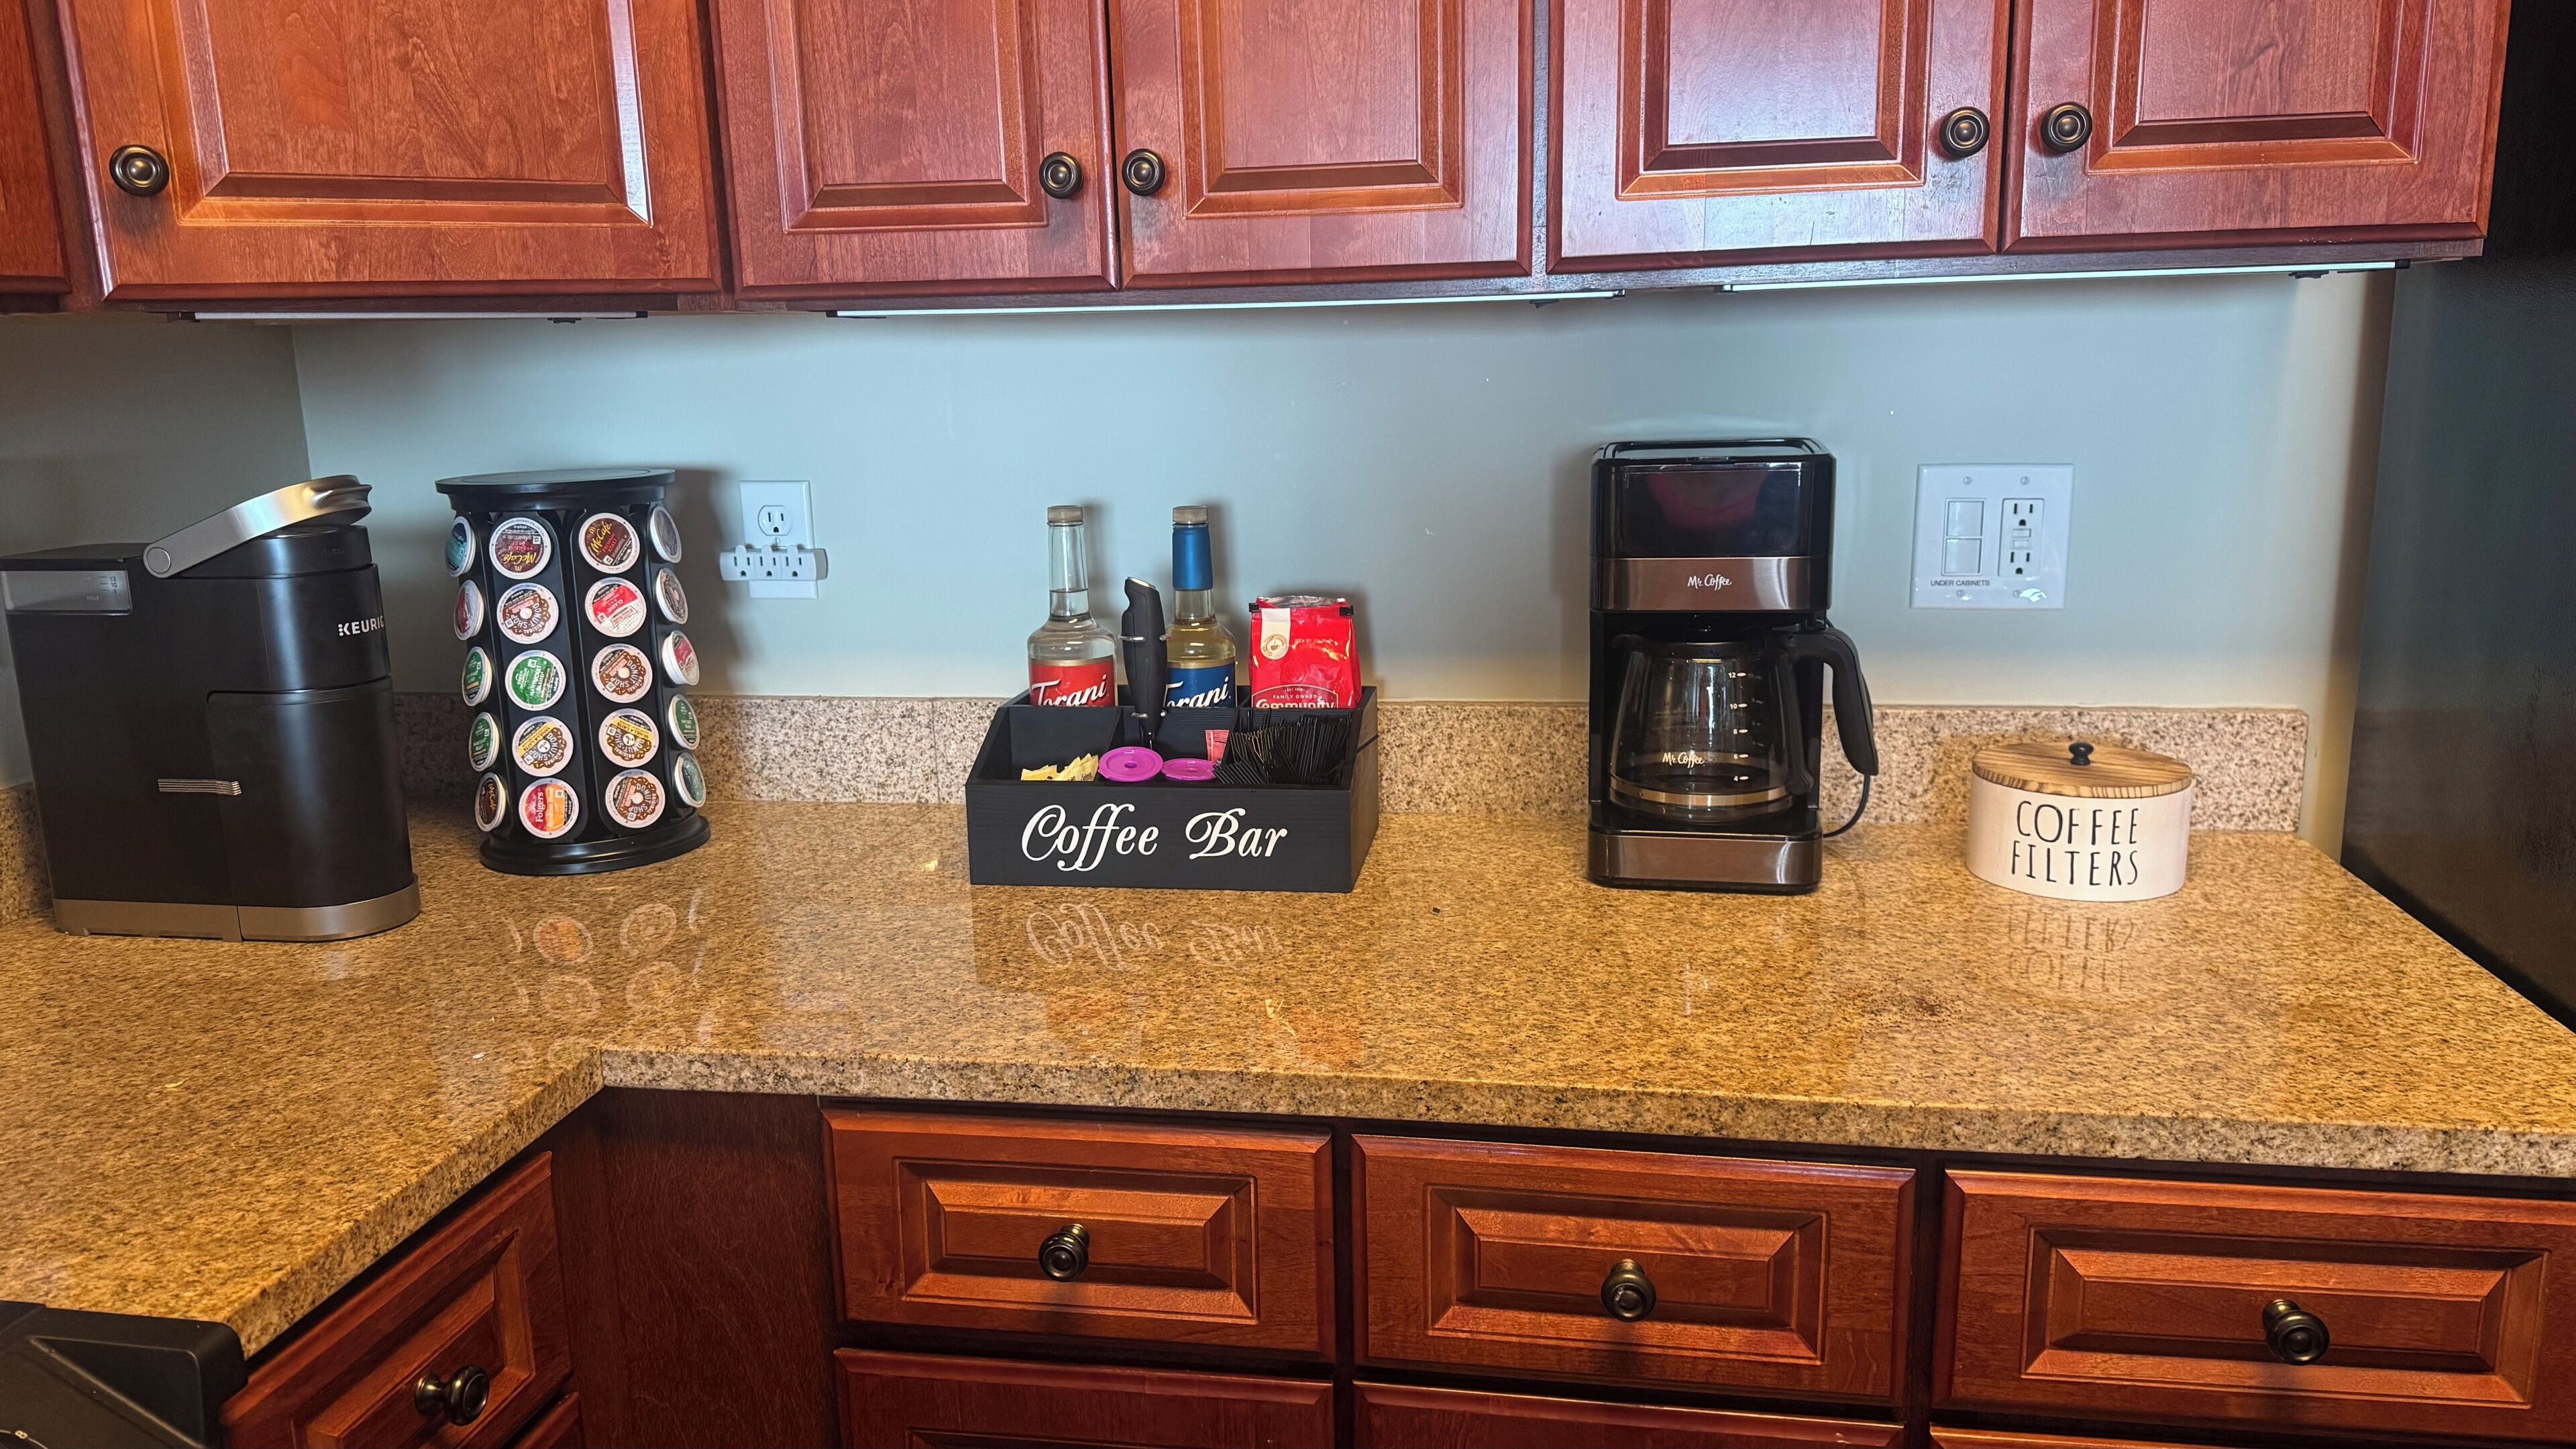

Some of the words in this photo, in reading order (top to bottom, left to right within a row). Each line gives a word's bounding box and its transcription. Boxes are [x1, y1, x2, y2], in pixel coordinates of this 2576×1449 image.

[1687, 576, 1703, 589] Mr.
[1704, 574, 1733, 590] Coffee
[511, 614, 528, 629] SHOP
[530, 602, 541, 627] DONUT
[627, 660, 639, 684] DONUT
[610, 677, 630, 688] SHOP
[547, 733, 558, 757] DONUT
[615, 729, 624, 748] SHOP
[624, 738, 645, 753] DONUT
[528, 750, 548, 761] SHOP
[1662, 752, 1676, 765] Mr.
[1677, 751, 1705, 769] Coffee
[637, 784, 651, 804] DONUT
[535, 792, 545, 822] Folgers
[629, 804, 647, 813] SHOP
[2017, 800, 2139, 846] COFFEE
[1022, 803, 1159, 872] Coffee
[1185, 808, 1288, 860] Bar
[2011, 840, 2139, 887] FILTERS
[15, 1430, 28, 1439] 8
